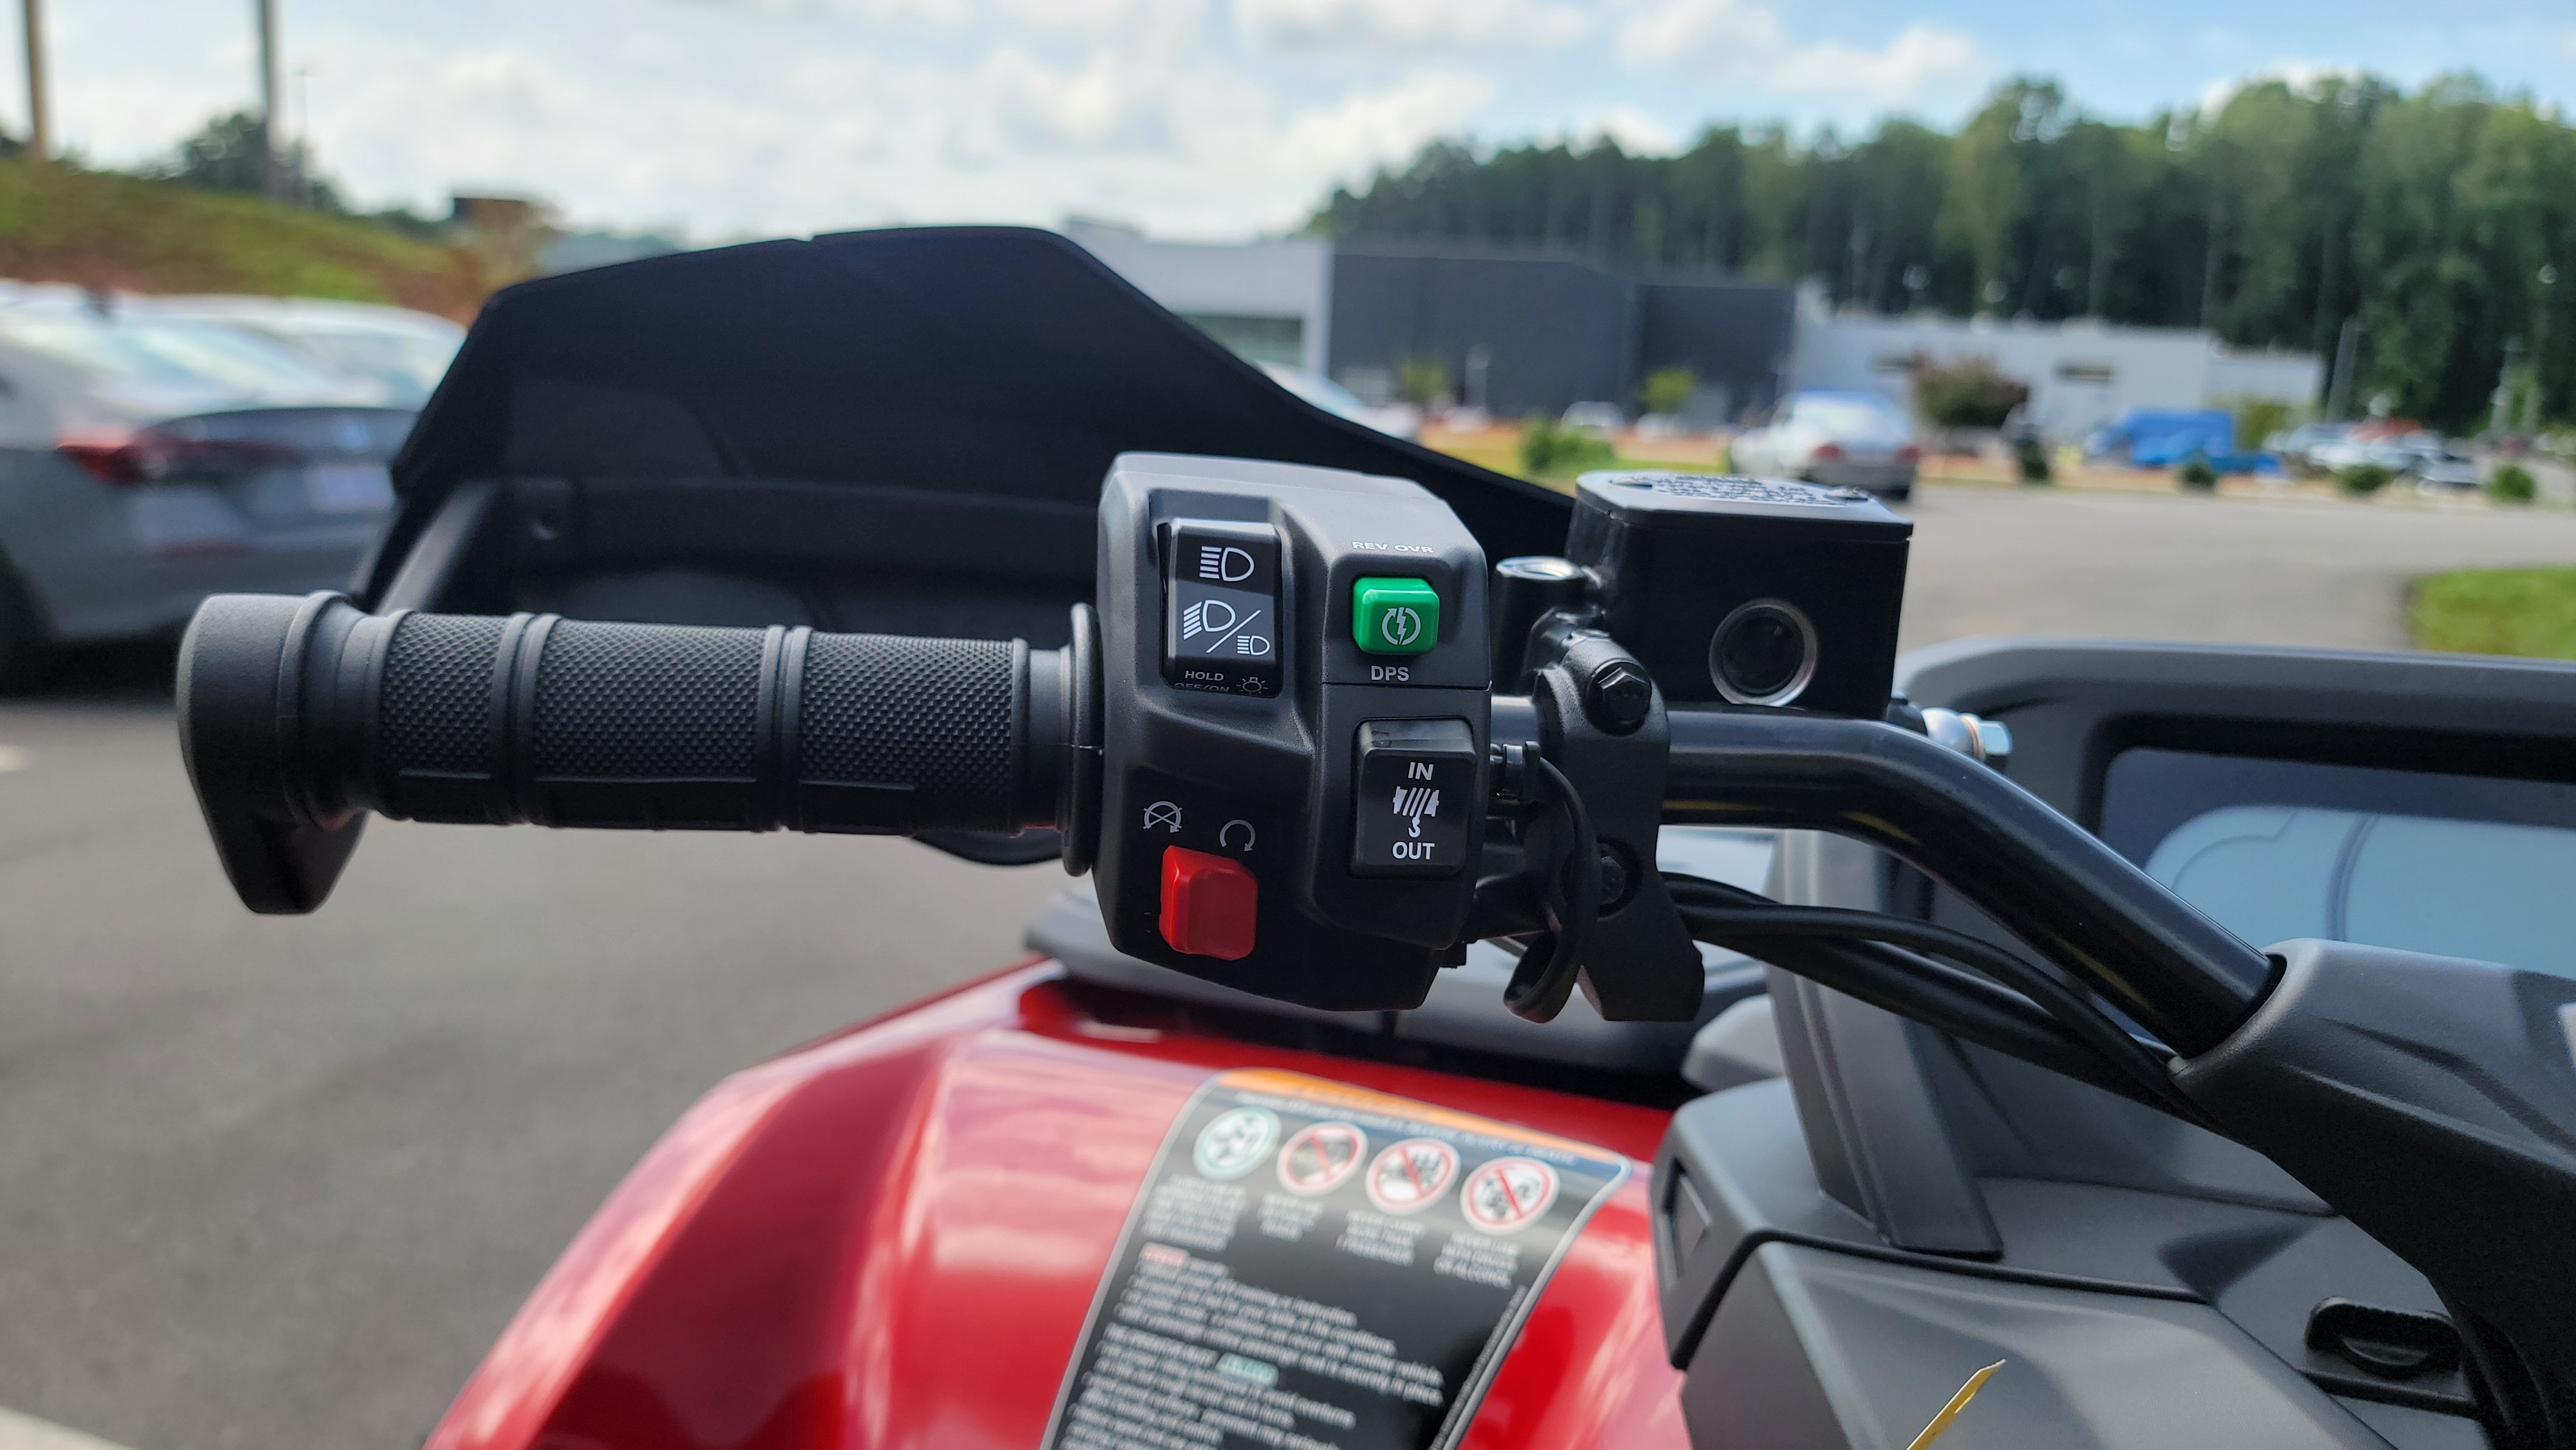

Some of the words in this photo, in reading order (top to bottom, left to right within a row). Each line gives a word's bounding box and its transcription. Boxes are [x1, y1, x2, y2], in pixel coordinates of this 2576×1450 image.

[1352, 541, 1388, 551] REV
[1394, 545, 1434, 553] OVR
[1185, 670, 1224, 681] HOLD
[1370, 665, 1410, 683] DPS
[1408, 762, 1434, 781] IN
[1392, 842, 1435, 861] OUT
